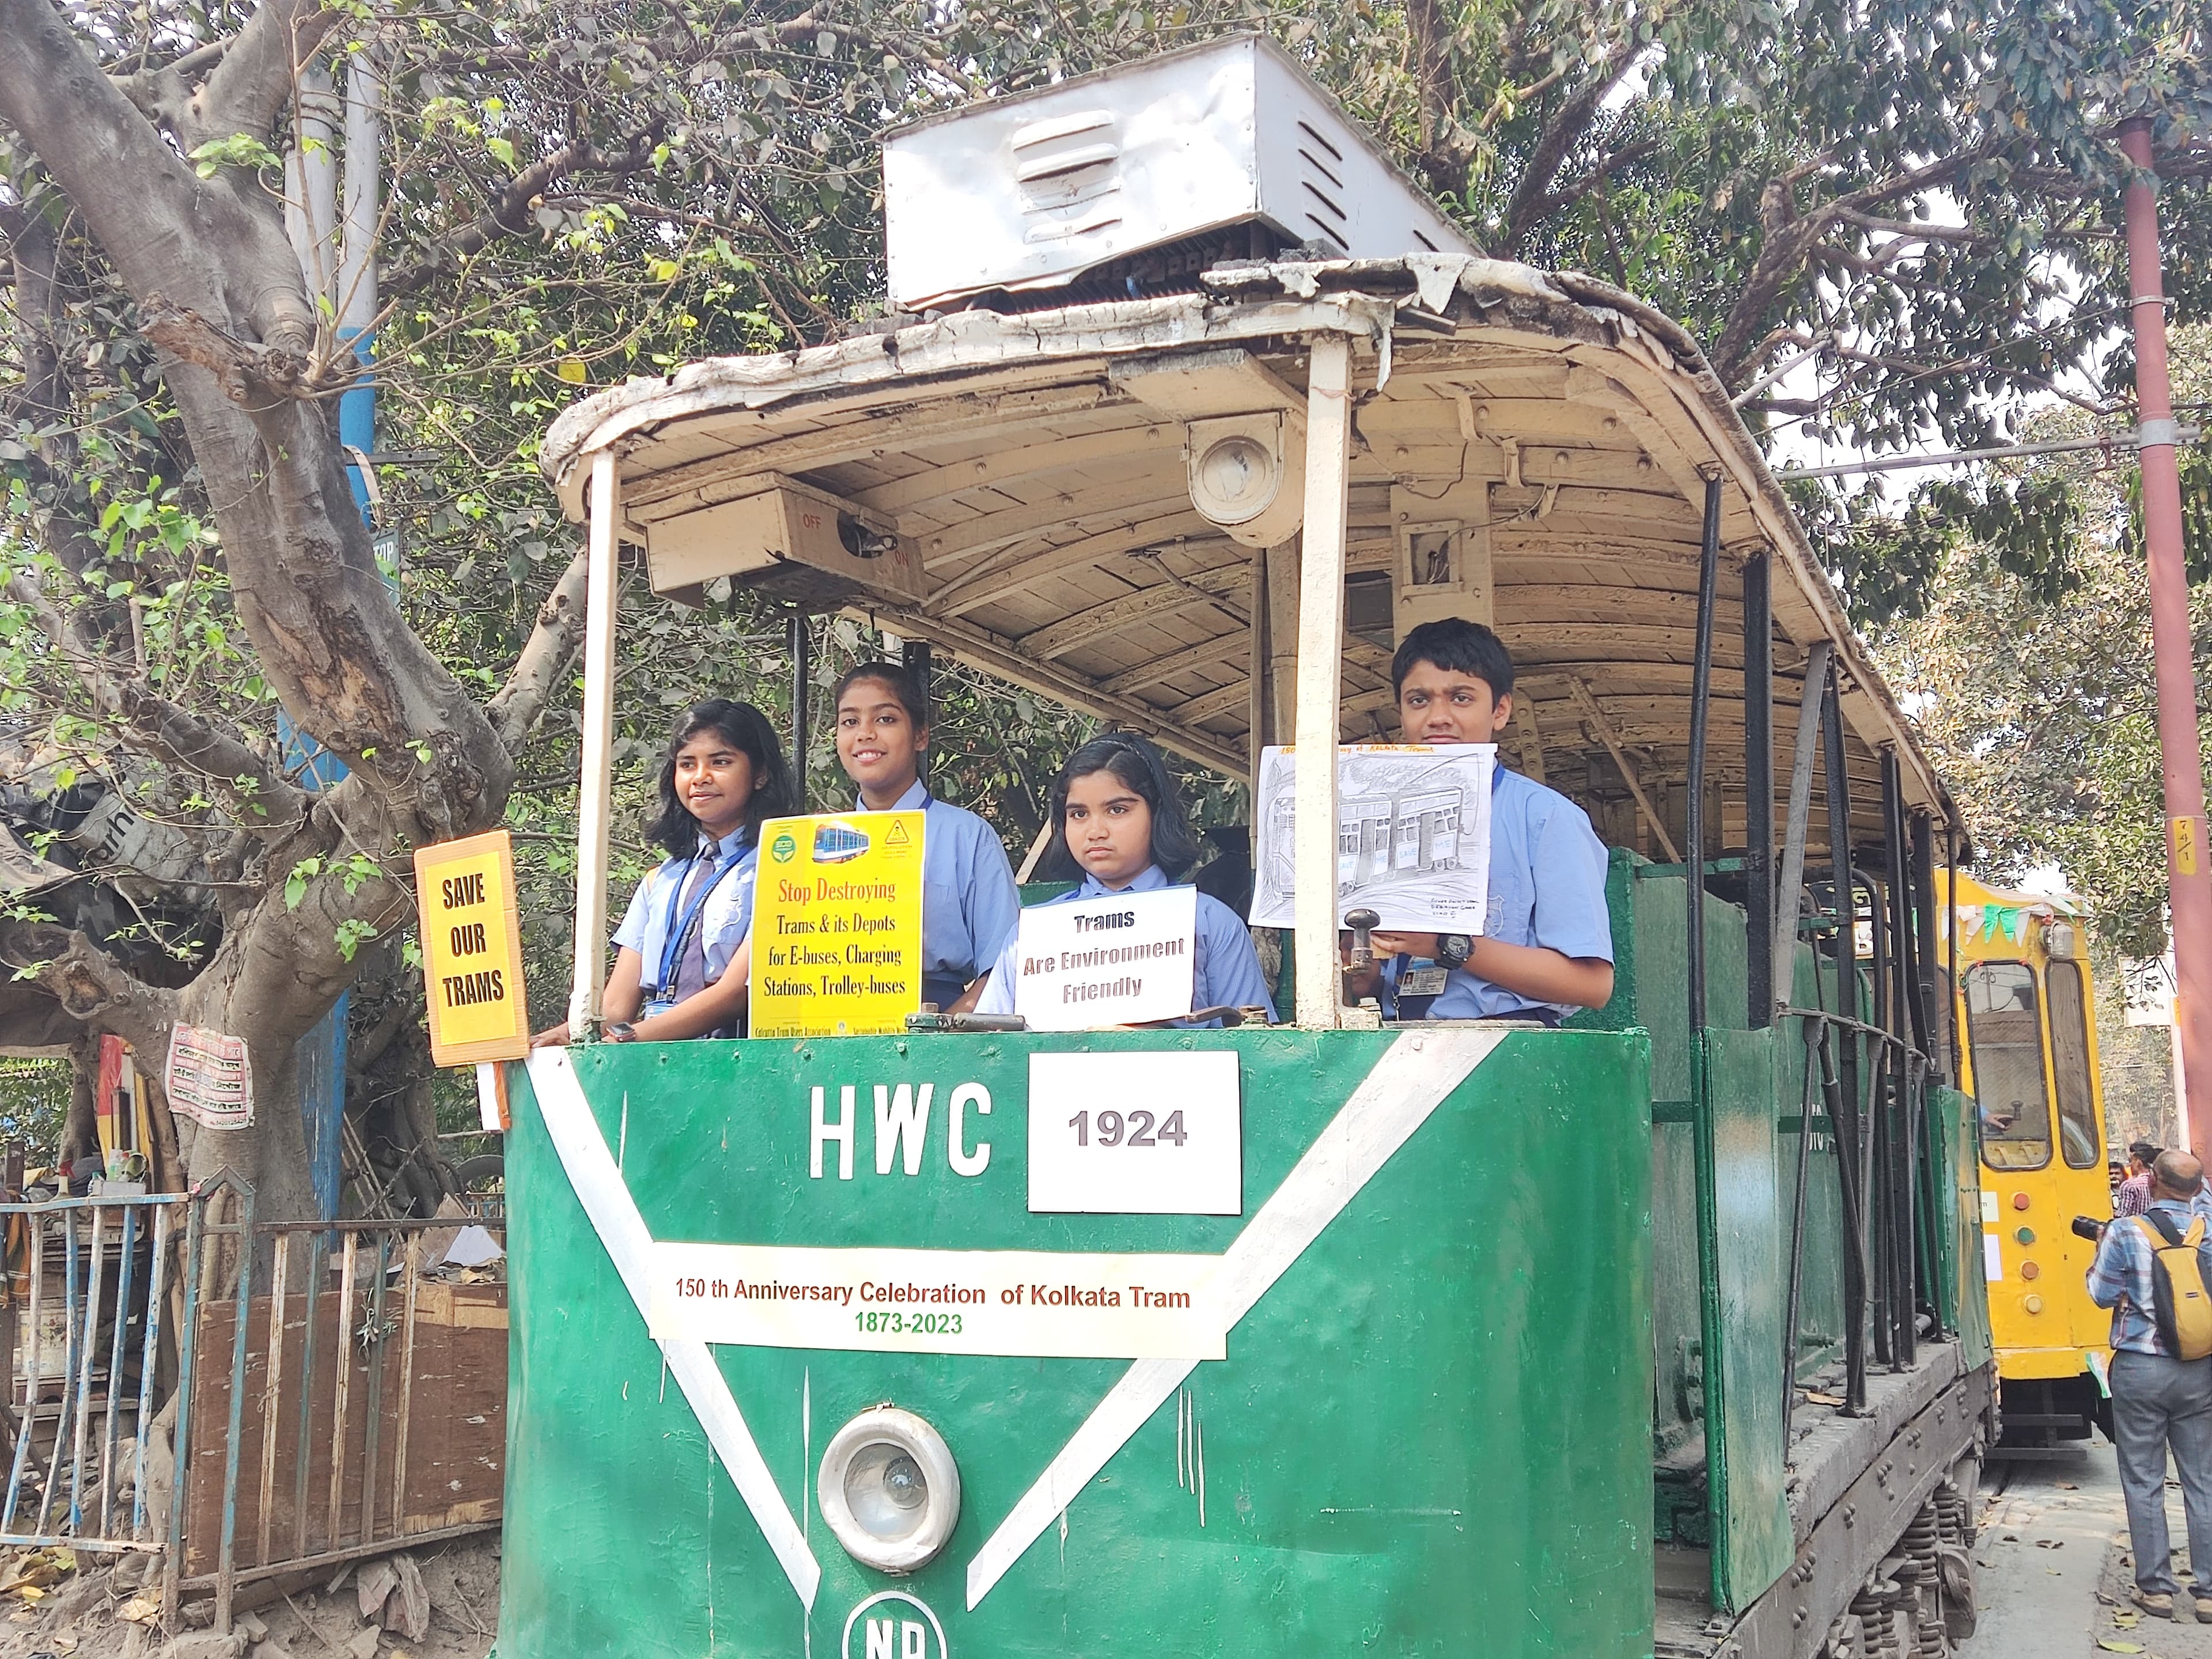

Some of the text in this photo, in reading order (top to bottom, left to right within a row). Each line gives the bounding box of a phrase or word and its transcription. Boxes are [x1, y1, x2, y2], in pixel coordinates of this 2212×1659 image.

[803, 513, 821, 529] OFF
[895, 551, 910, 567] ON
[1399, 840, 1452, 858] SAVE ME
[442, 873, 485, 910] SAVE
[779, 878, 896, 906] Stop Destroying
[777, 915, 895, 935] Trams & its Depots
[1075, 912, 1135, 932] Trams
[450, 923, 486, 957] OUR
[768, 944, 902, 969] for E-buses, Charging
[1024, 938, 1185, 976] Are Environment
[443, 970, 504, 1007] TRAMS
[764, 976, 906, 998] Stations, Trolley-buses
[1063, 978, 1142, 1004] Friendly
[809, 1081, 992, 1181] HWC
[1069, 1111, 1188, 1147] 1924
[675, 1278, 1191, 1309] 150 th Anniversary Celebration of Kolkata Tram
[854, 1311, 964, 1335] 1873-2023
